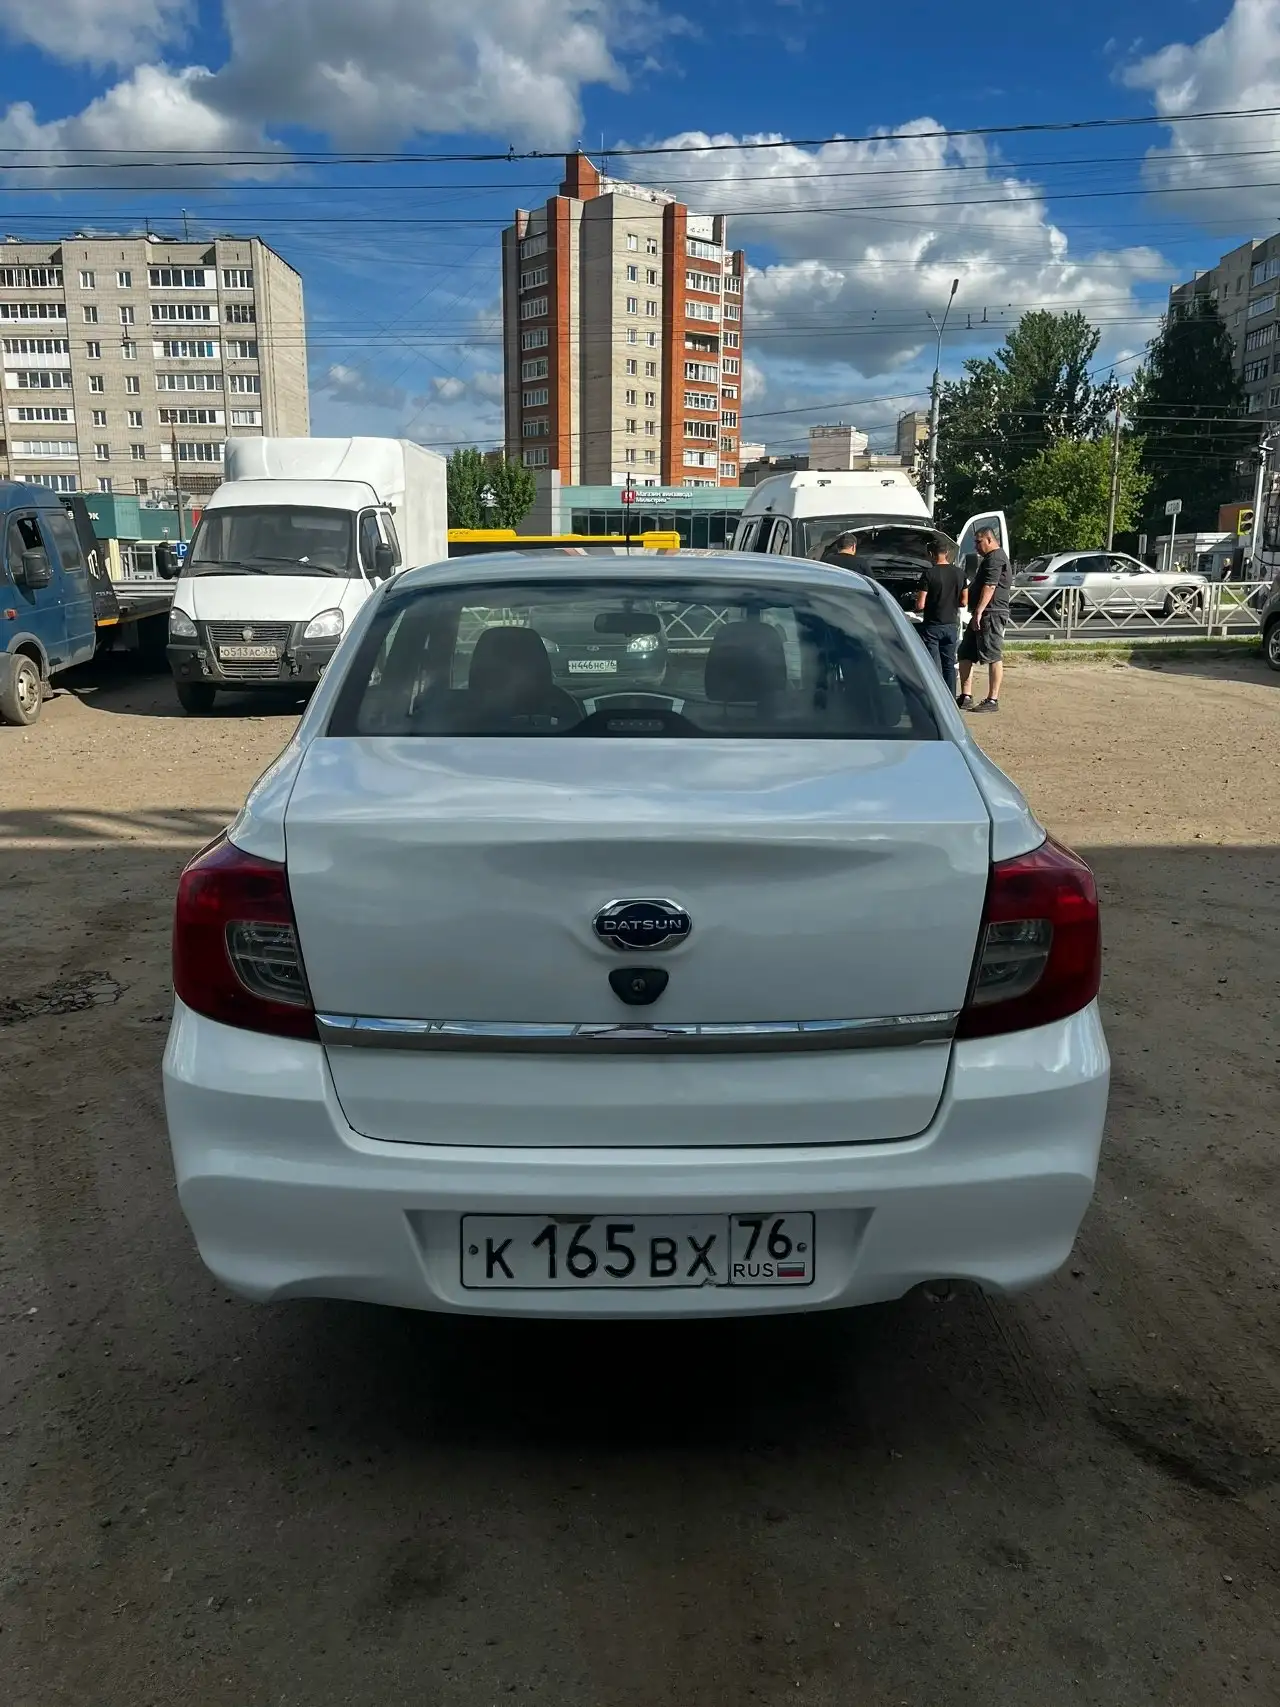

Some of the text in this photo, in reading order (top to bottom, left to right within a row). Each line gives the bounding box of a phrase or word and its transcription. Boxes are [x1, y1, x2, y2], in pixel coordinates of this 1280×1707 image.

[179, 543, 188, 556] P
[603, 919, 682, 931] DATSUN
[738, 1218, 793, 1261] 76
[733, 1263, 774, 1278] RUS
